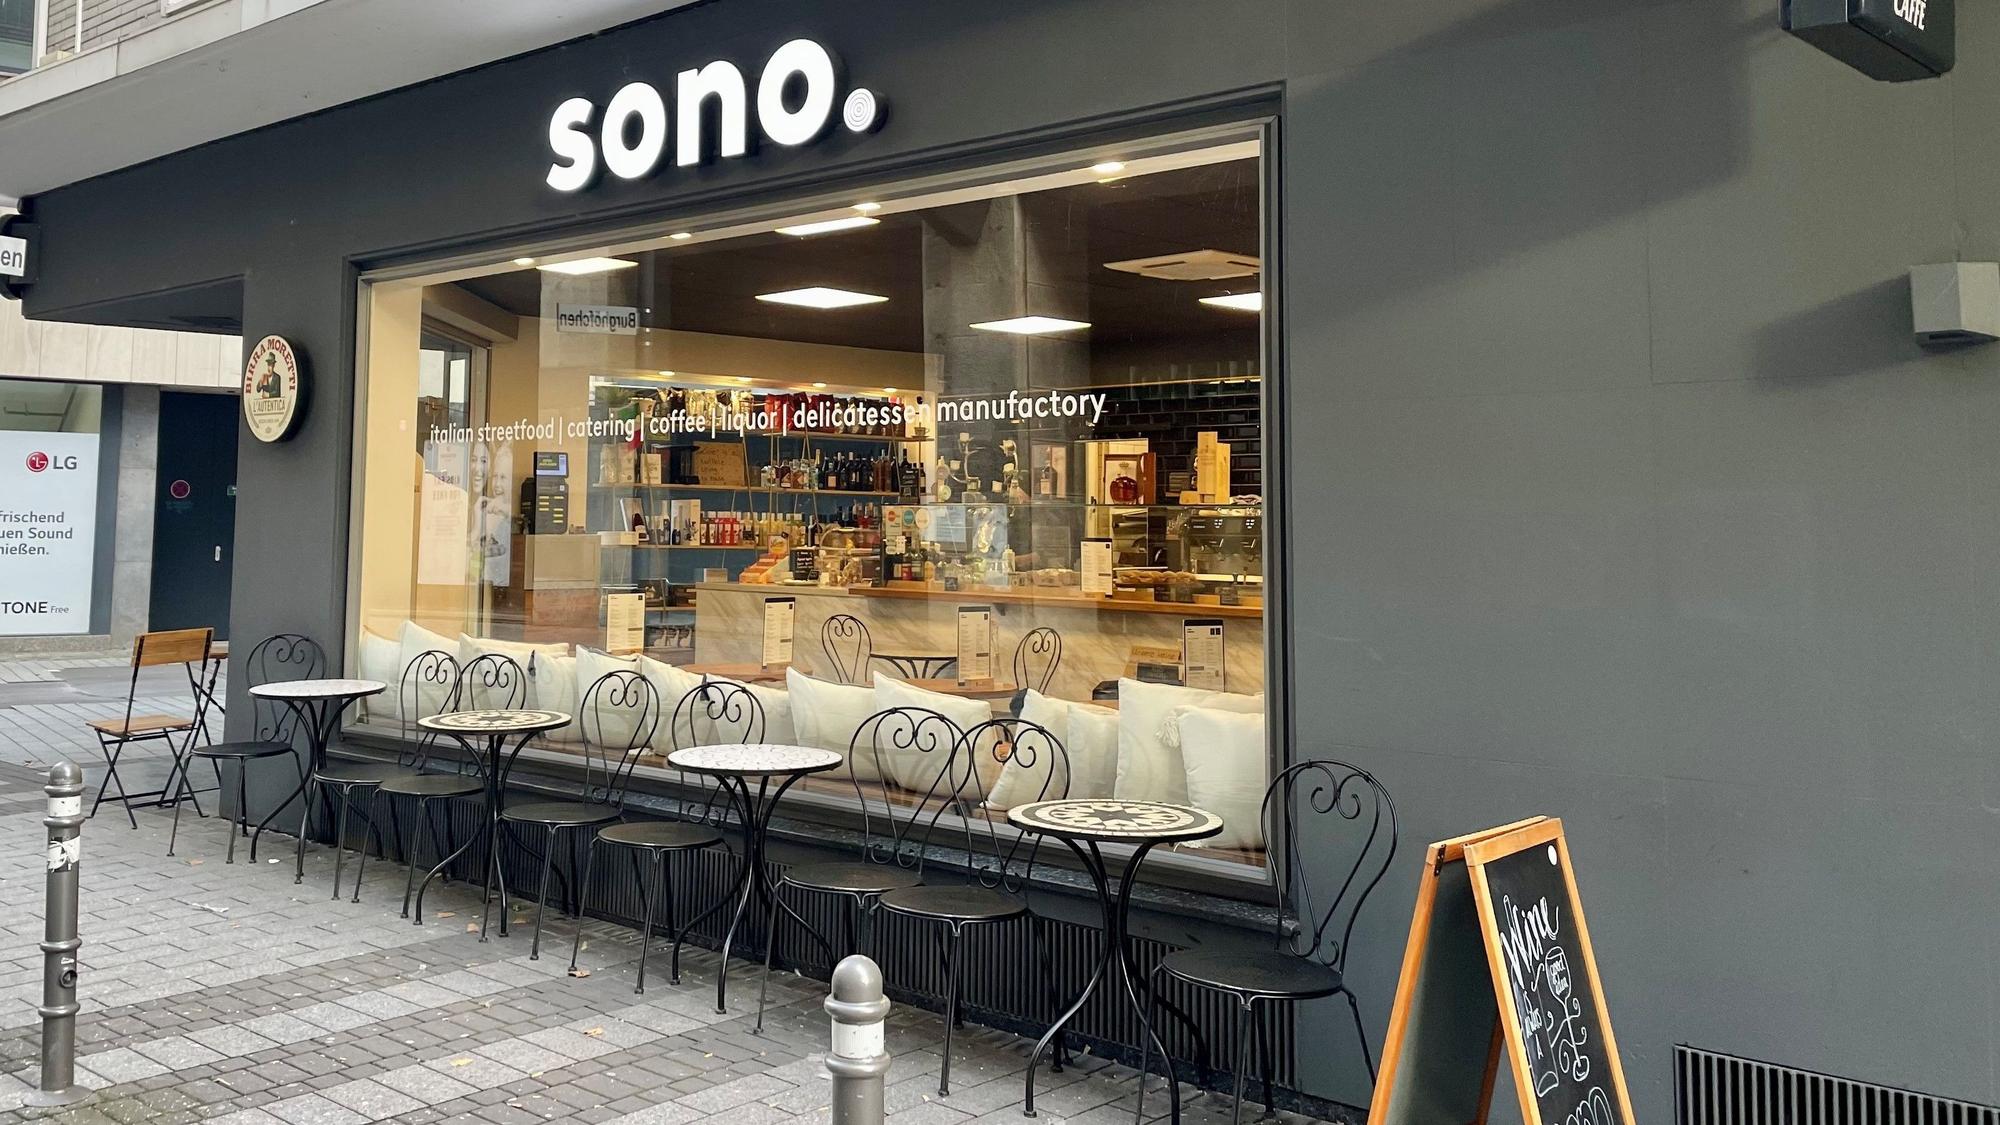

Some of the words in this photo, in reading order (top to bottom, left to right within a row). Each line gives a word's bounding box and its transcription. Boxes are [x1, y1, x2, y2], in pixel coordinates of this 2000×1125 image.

[245, 343, 266, 394] BIRRA
[267, 338, 296, 391] MORETTI
[430, 422, 474, 444] italian
[477, 416, 554, 442] streetfood
[567, 413, 635, 441] catering
[649, 408, 706, 434] coffee
[721, 402, 777, 437] liquor
[793, 400, 930, 429] delicatessen
[937, 390, 1106, 424] manufactory
[53, 455, 77, 470] LG
[28, 527, 73, 539] Sound
[1, 601, 48, 614] TONE
[50, 604, 69, 614] Free
[1500, 894, 1559, 990] Wine
